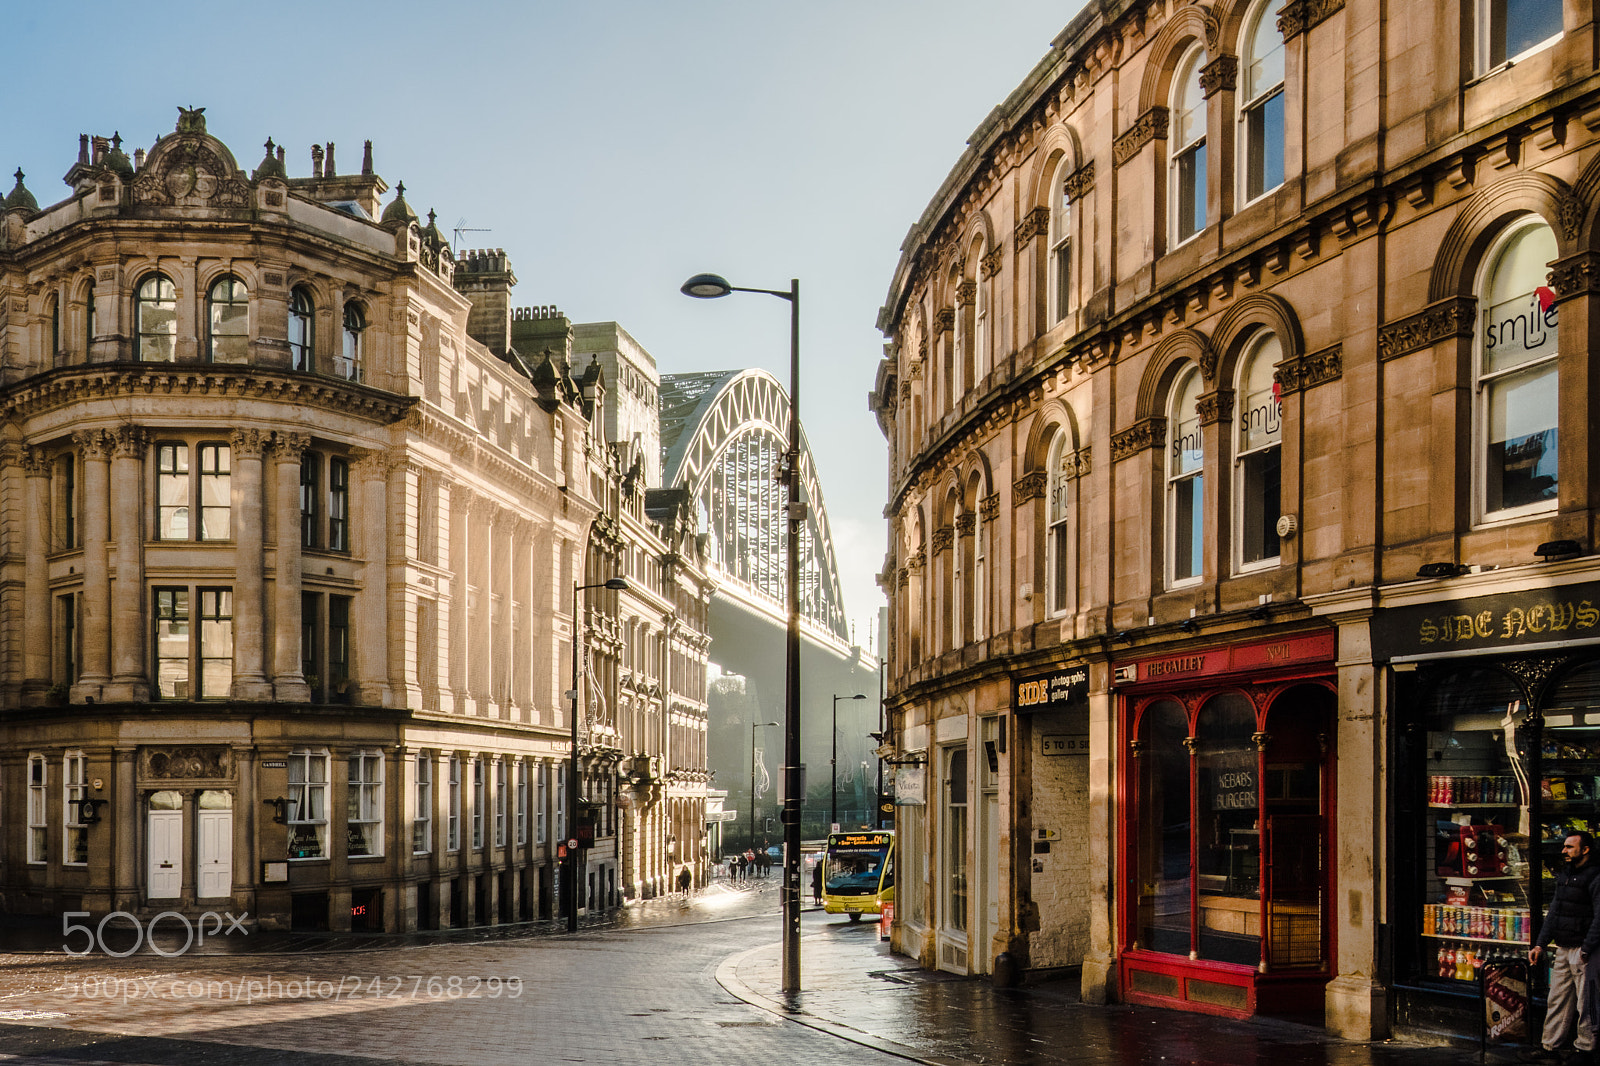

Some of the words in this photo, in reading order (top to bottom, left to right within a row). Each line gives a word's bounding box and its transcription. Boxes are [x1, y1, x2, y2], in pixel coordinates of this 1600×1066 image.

[1486, 300, 1559, 350] smile
[1173, 424, 1203, 461] smil
[1419, 609, 1494, 645] SIDE
[1500, 600, 1600, 639] NEWS
[1146, 662, 1163, 676] THE
[1163, 656, 1206, 674] GALLEY
[1051, 670, 1086, 689] photogaphic
[1018, 680, 1049, 706] SIDE
[1051, 688, 1069, 703] gallery
[1044, 740, 1050, 750] 5
[1054, 741, 1064, 749] TO
[1219, 771, 1252, 789] KEBABS
[1216, 791, 1256, 809] BURGERS
[874, 835, 882, 844] Q1
[1490, 1007, 1524, 1038] Rollover
